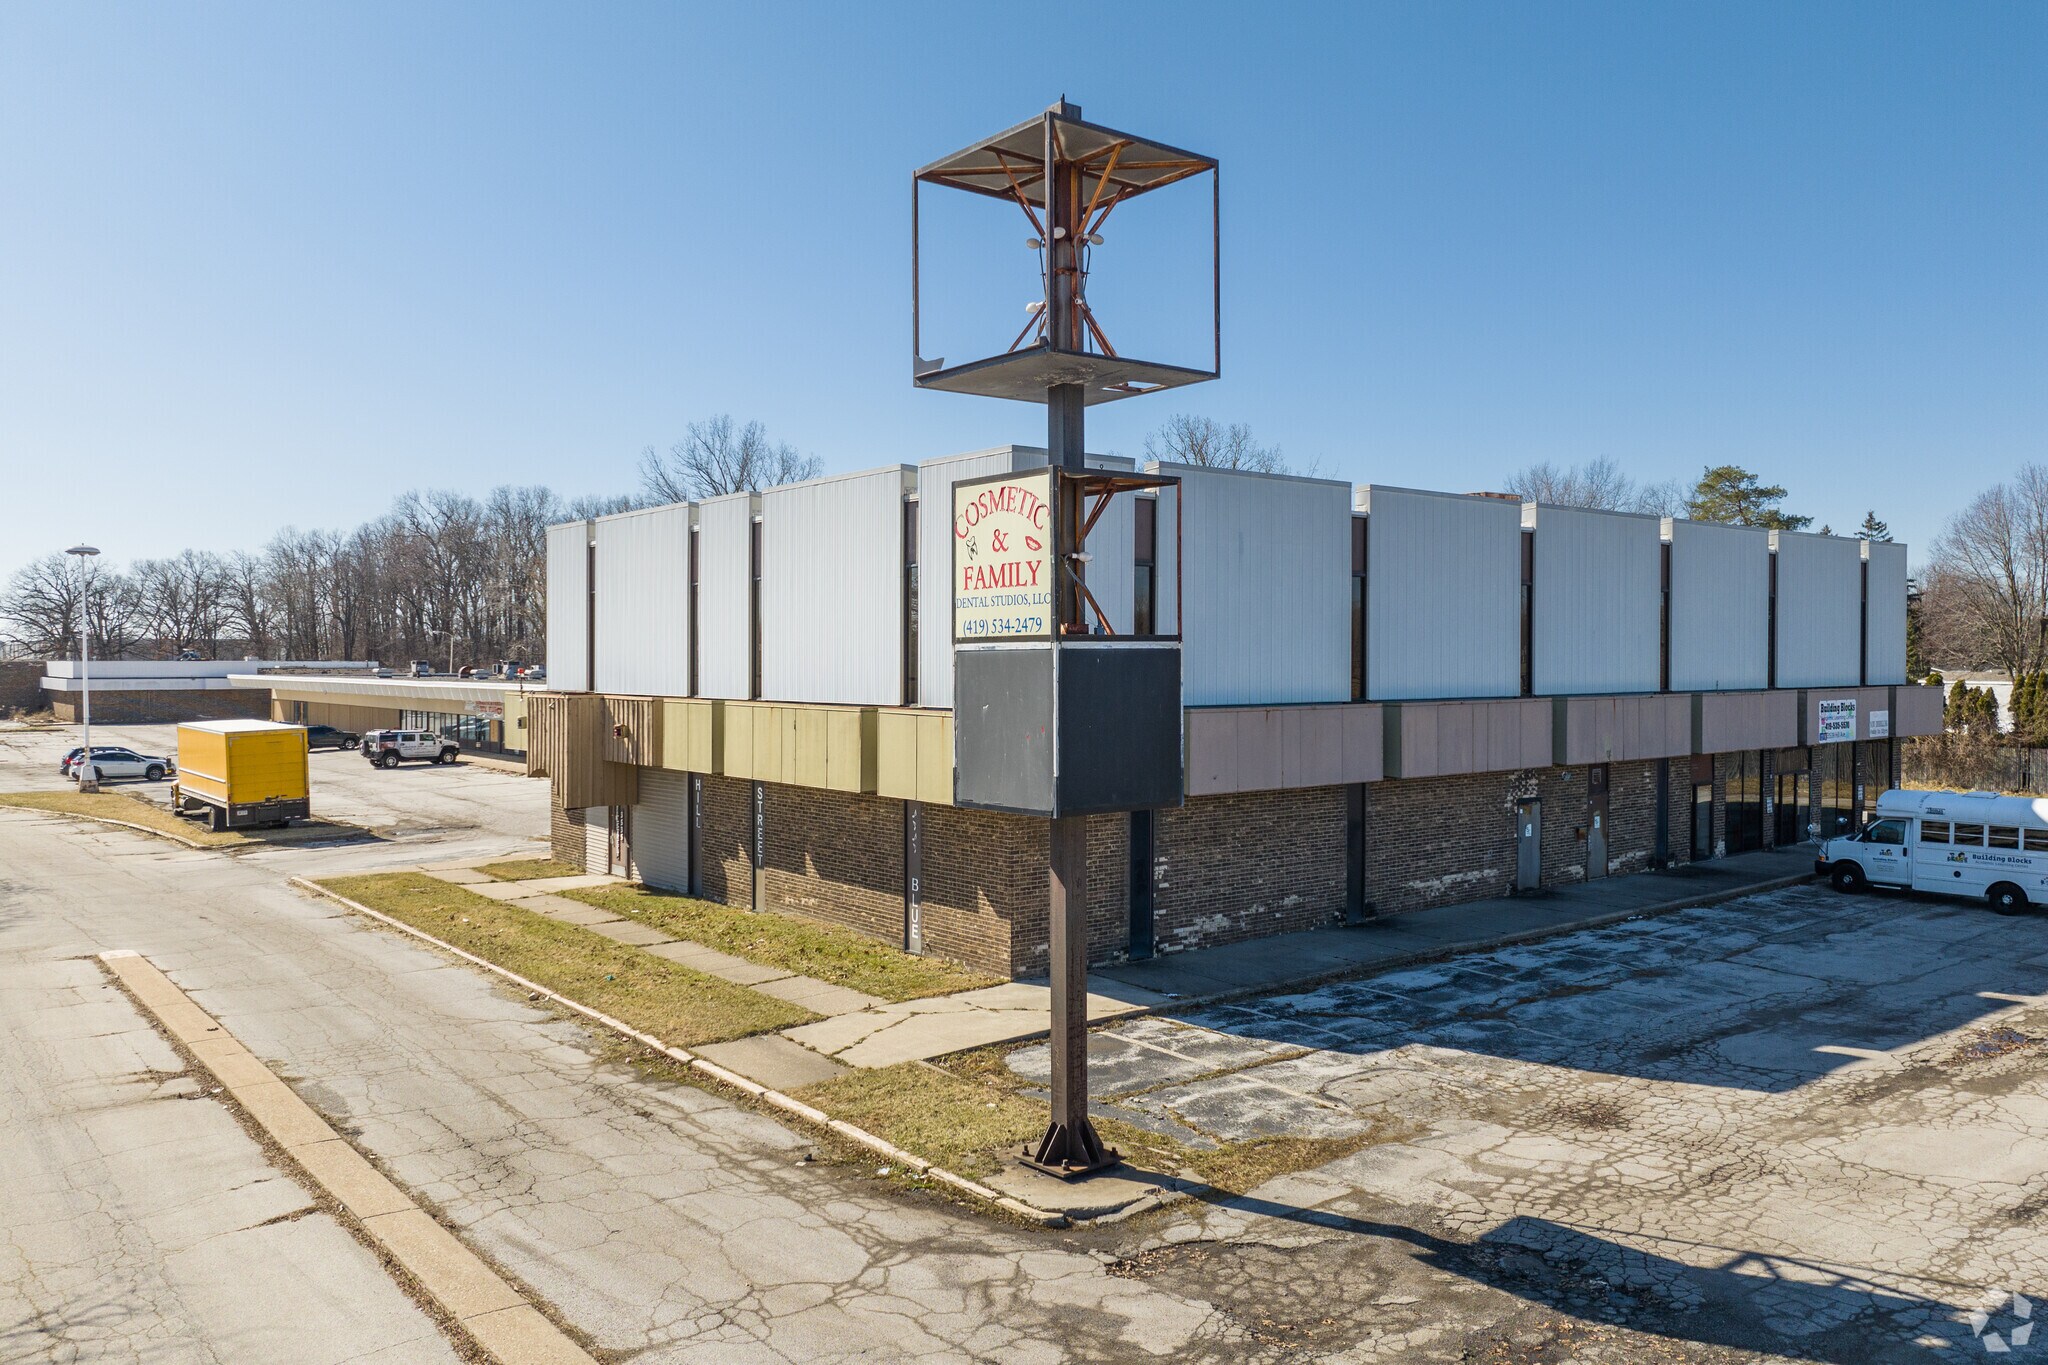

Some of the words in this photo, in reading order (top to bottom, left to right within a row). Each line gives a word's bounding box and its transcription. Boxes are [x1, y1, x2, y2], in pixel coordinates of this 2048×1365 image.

[954, 486, 1050, 539] COSMETIC
[992, 528, 1009, 553] &
[963, 560, 1042, 591] FAMILY
[956, 596, 989, 609] DENTAL
[991, 593, 1031, 607] STUDIOS,
[1032, 592, 1051, 605] LLC
[963, 618, 989, 637] (419)
[991, 616, 1042, 634] 534-2479
[1820, 704, 1840, 714] Building
[1841, 702, 1855, 711] Blocks
[1972, 854, 2005, 863] Building
[2007, 857, 2032, 865] Blocks
[911, 877, 919, 939] BLUE
